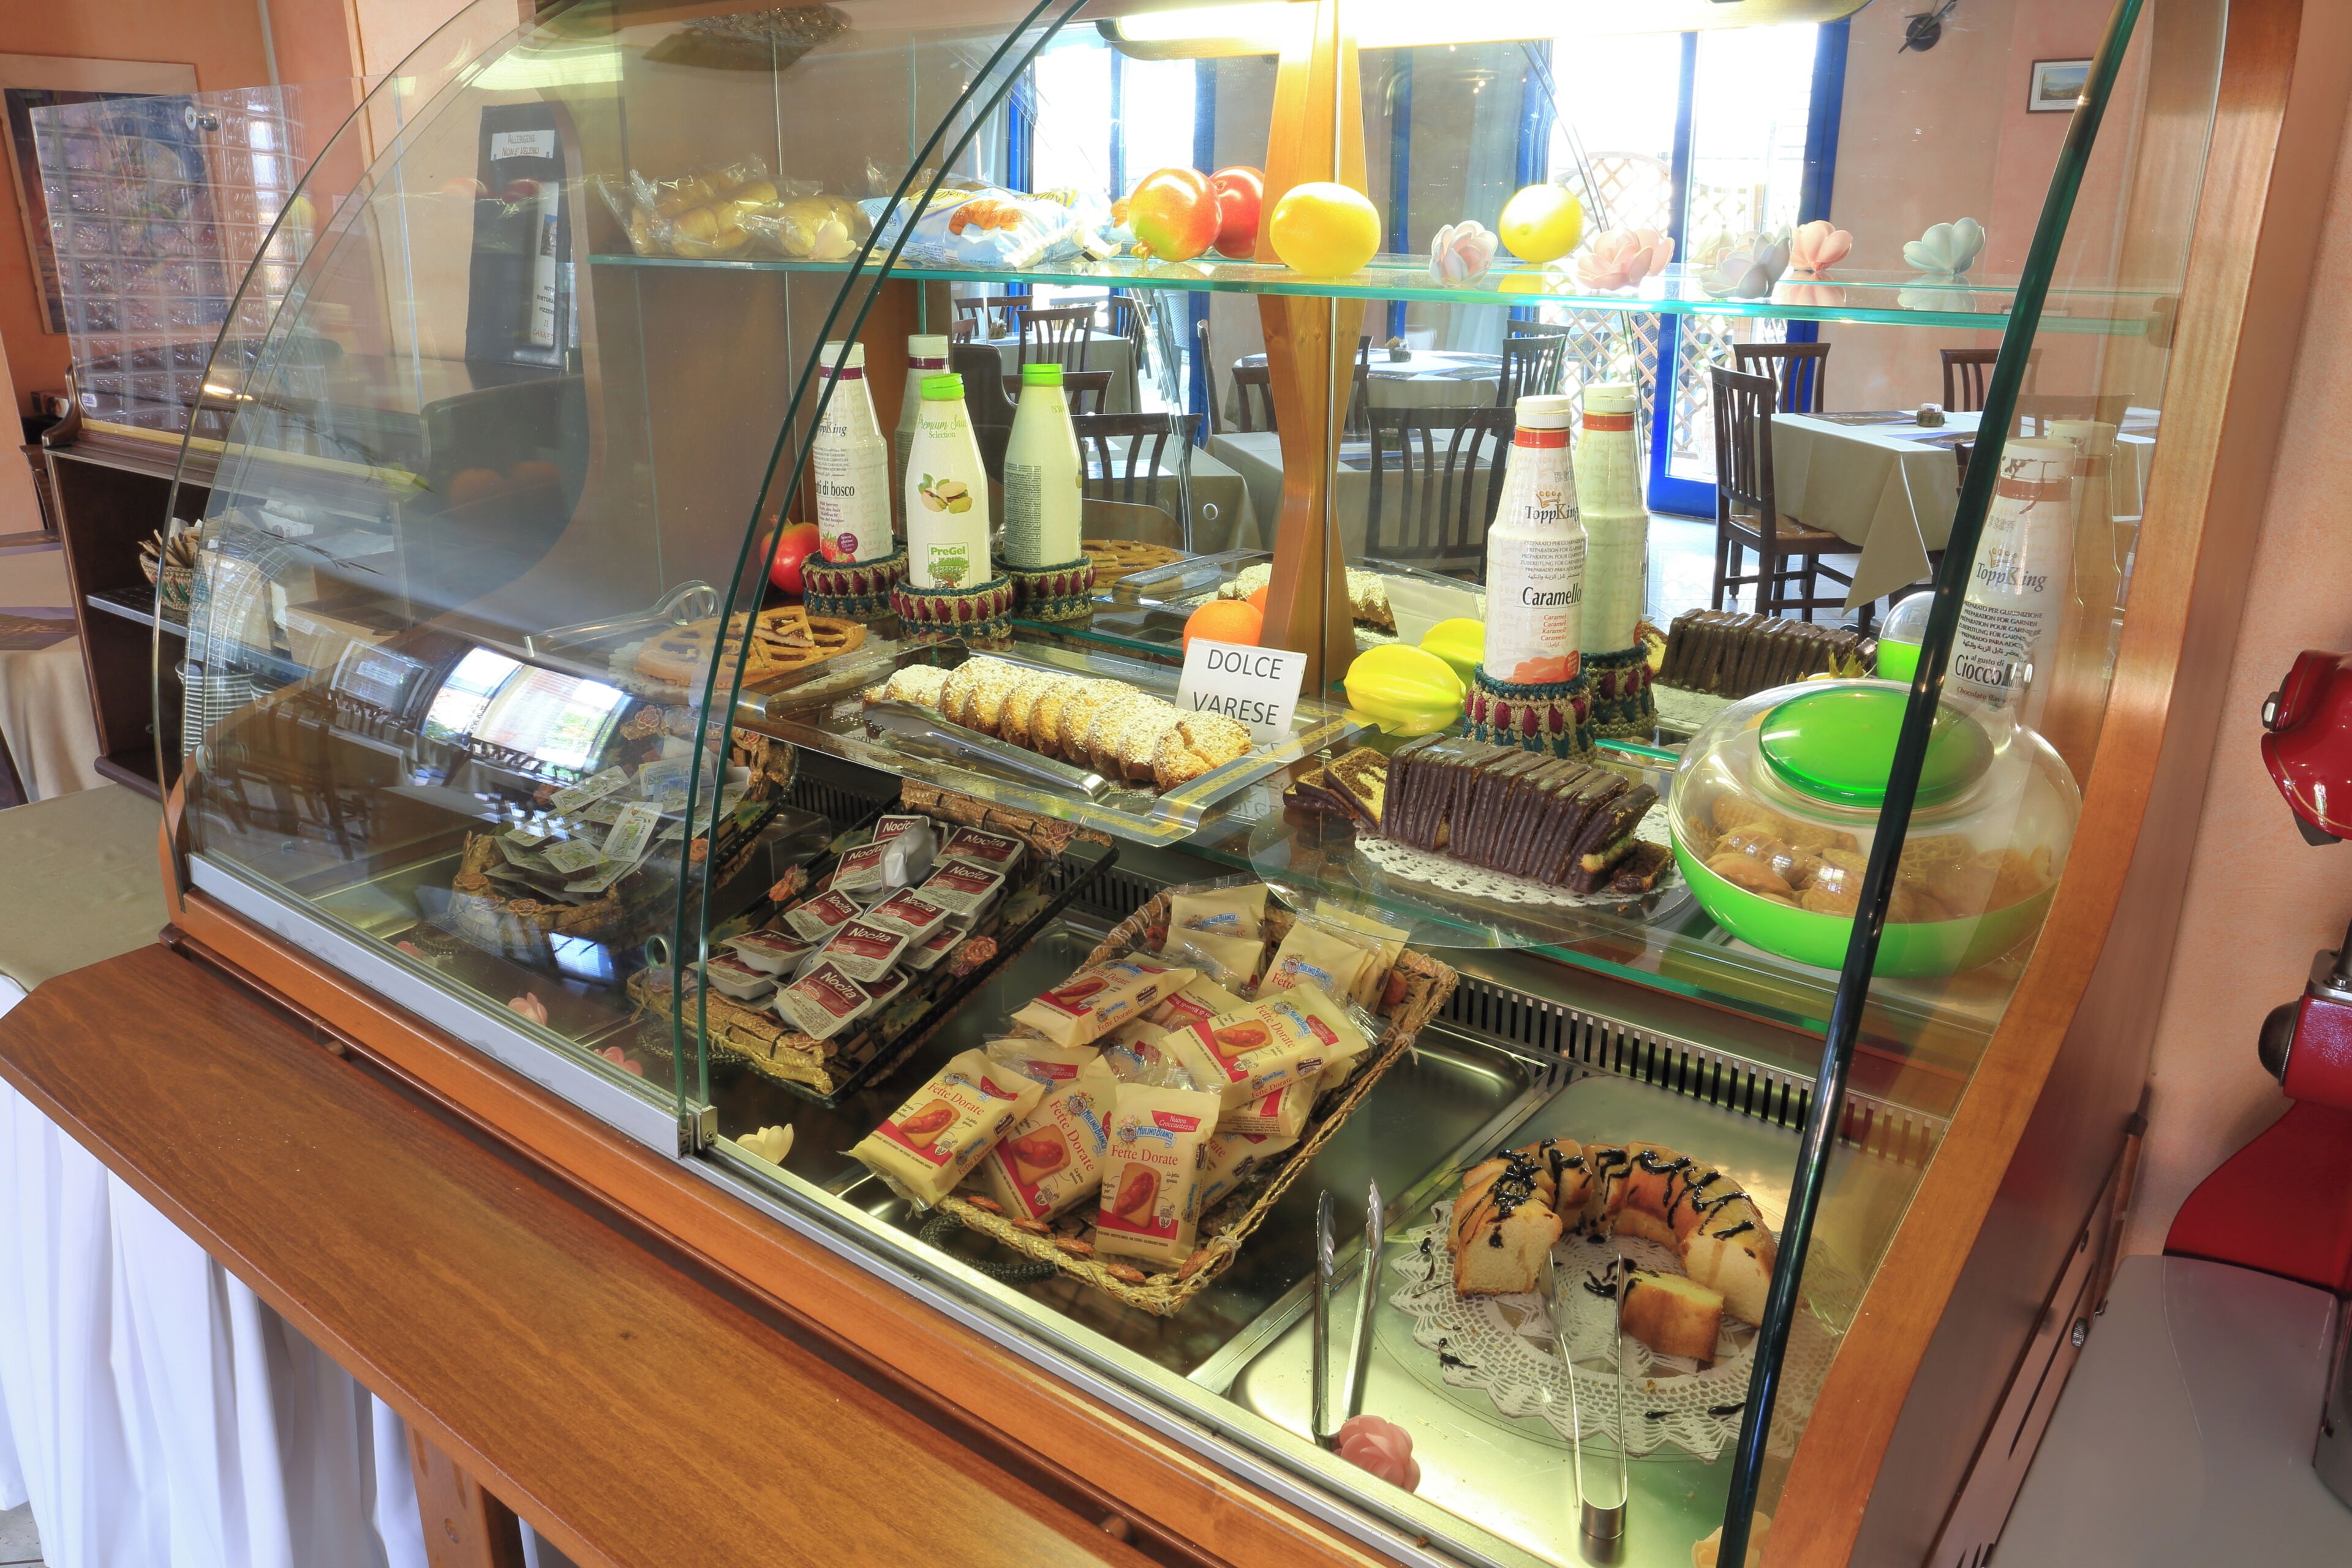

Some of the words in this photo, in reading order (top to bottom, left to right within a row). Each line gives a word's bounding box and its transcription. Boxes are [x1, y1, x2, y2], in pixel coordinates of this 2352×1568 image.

[916, 413, 948, 430] Premium
[823, 481, 829, 495] di
[831, 481, 854, 496] bosco
[931, 546, 965, 555] PreGel
[1977, 562, 2048, 592] ToppKing
[1523, 582, 1581, 606] Caramello
[1964, 609, 1996, 621] PREPARATION
[1962, 631, 1988, 642] PREPARADO
[1207, 649, 1283, 680] DOLCE
[1957, 686, 1987, 699] Chocolate
[1194, 691, 1280, 726] VARESE
[883, 820, 914, 832] Nocit
[962, 834, 1007, 848] Nocita
[949, 865, 989, 881] Nocita
[825, 895, 853, 914] Nocita
[901, 895, 937, 913] Nocita
[848, 927, 892, 943] Nocita
[1298, 963, 1316, 976] MULINO
[820, 971, 857, 999] Nocita
[1272, 972, 1296, 990] Fette
[1098, 1019, 1112, 1031] Fette
[1113, 1008, 1134, 1023] Dorate
[1256, 1005, 1274, 1025] Fette
[1271, 1022, 1295, 1049] Dorate
[1251, 1087, 1268, 1099] Fette
[1269, 1077, 1293, 1091] Dorate
[927, 1082, 951, 1099] Fette
[951, 1093, 984, 1116] Dorate
[1082, 1109, 1099, 1131] MULINO
[1094, 1126, 1107, 1150] BIANCO
[1137, 1126, 1155, 1136] MULINO
[1156, 1128, 1174, 1139] BIANCO
[1159, 1119, 1194, 1131] Croccantezza
[1049, 1099, 1070, 1130] Fette
[1067, 1129, 1094, 1172] Dorate
[1111, 1145, 1137, 1159] Fette
[1141, 1148, 1178, 1166] Dorate
[1209, 1138, 1226, 1157] rate
